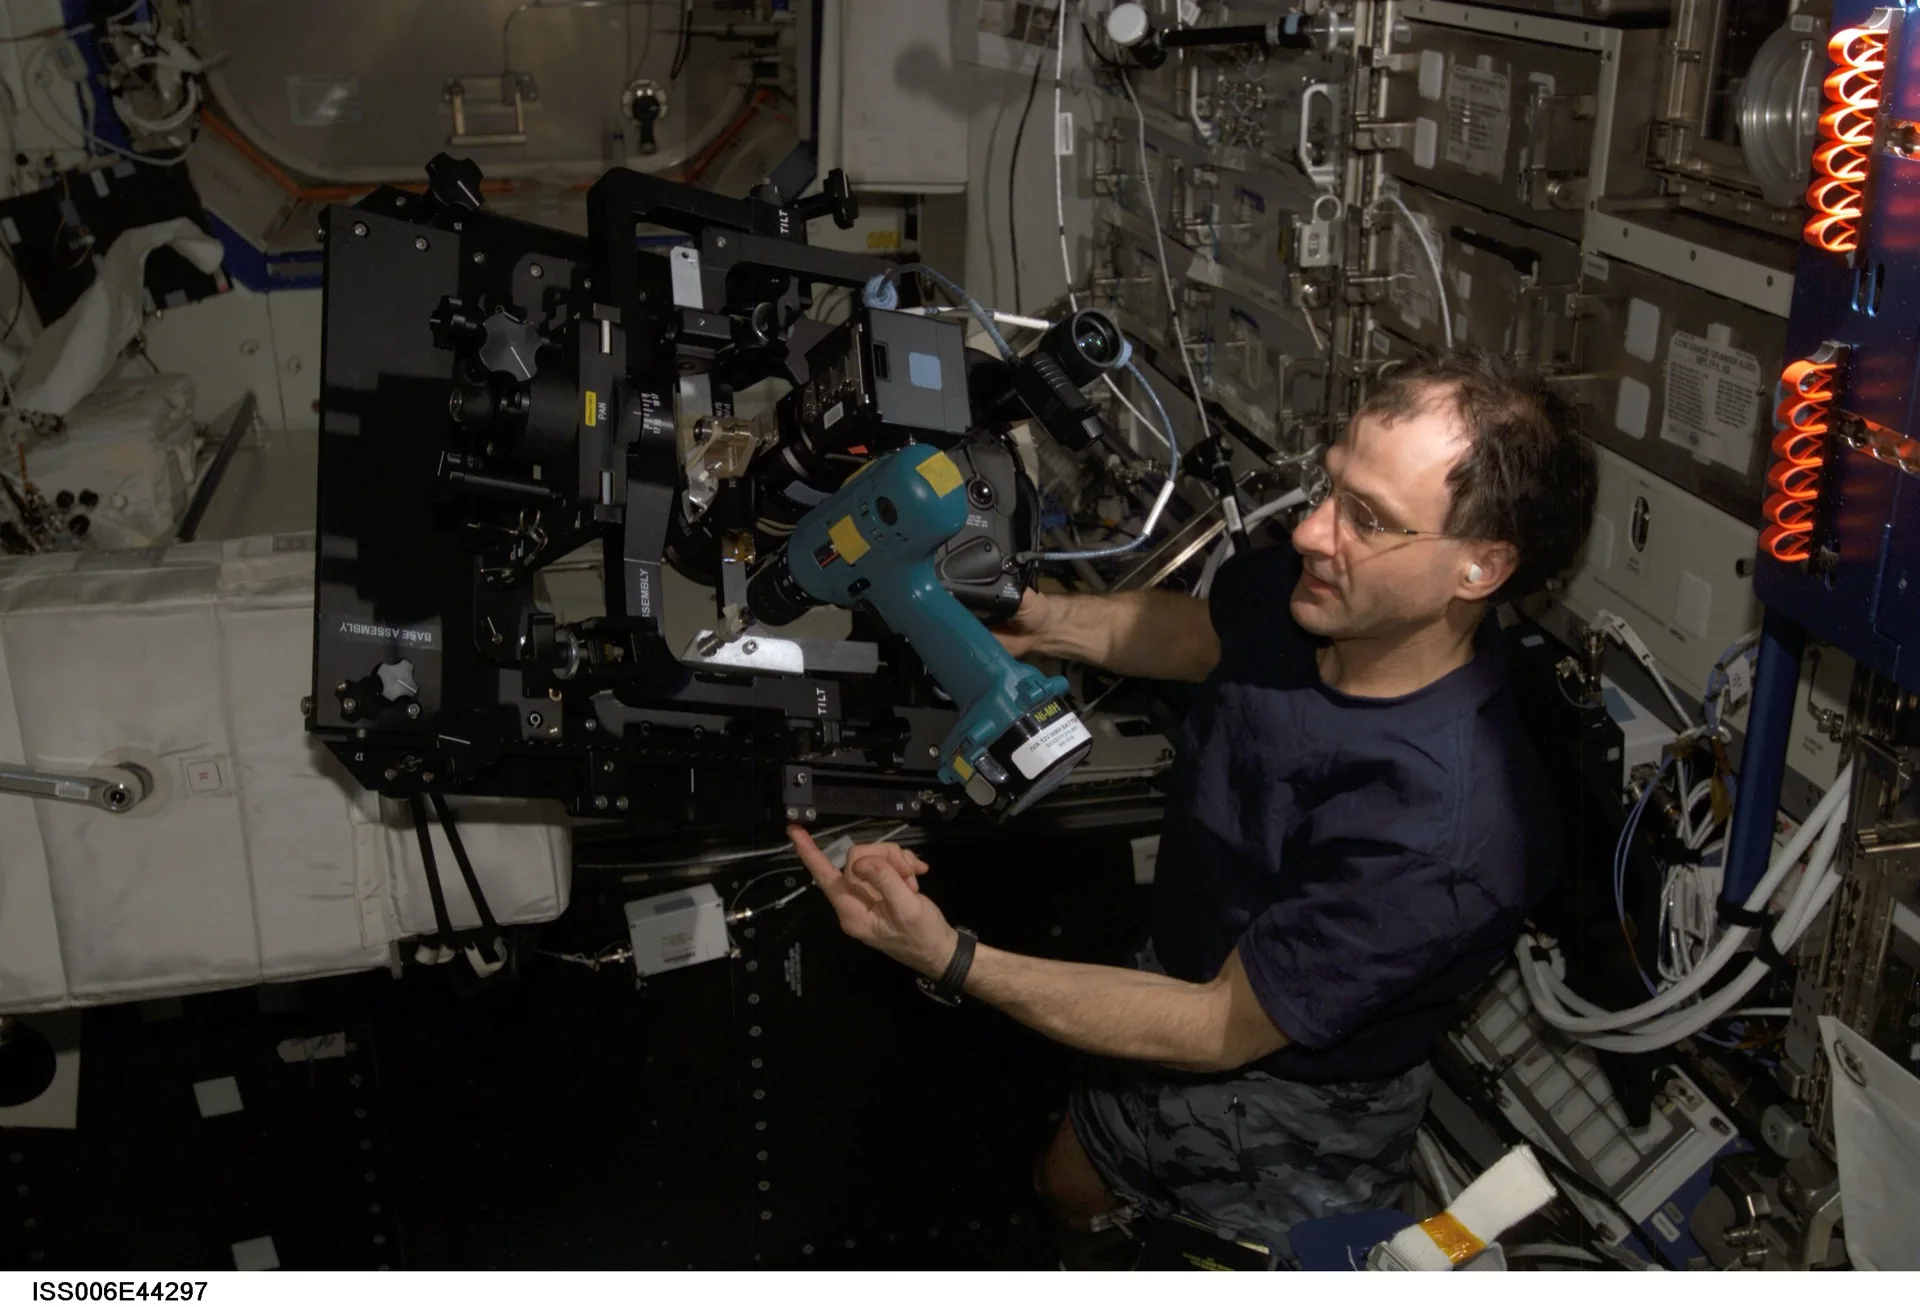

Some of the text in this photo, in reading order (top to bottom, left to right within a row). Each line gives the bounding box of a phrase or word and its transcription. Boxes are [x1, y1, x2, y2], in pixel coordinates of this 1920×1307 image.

[779, 209, 789, 234] TILT
[598, 402, 607, 421] PAN
[639, 567, 650, 617] SEMBLY
[339, 621, 432, 642] BASE ASSEMBLY
[816, 687, 827, 715] TILT
[1033, 701, 1062, 723] Ni-MH
[355, 751, 365, 762] 17
